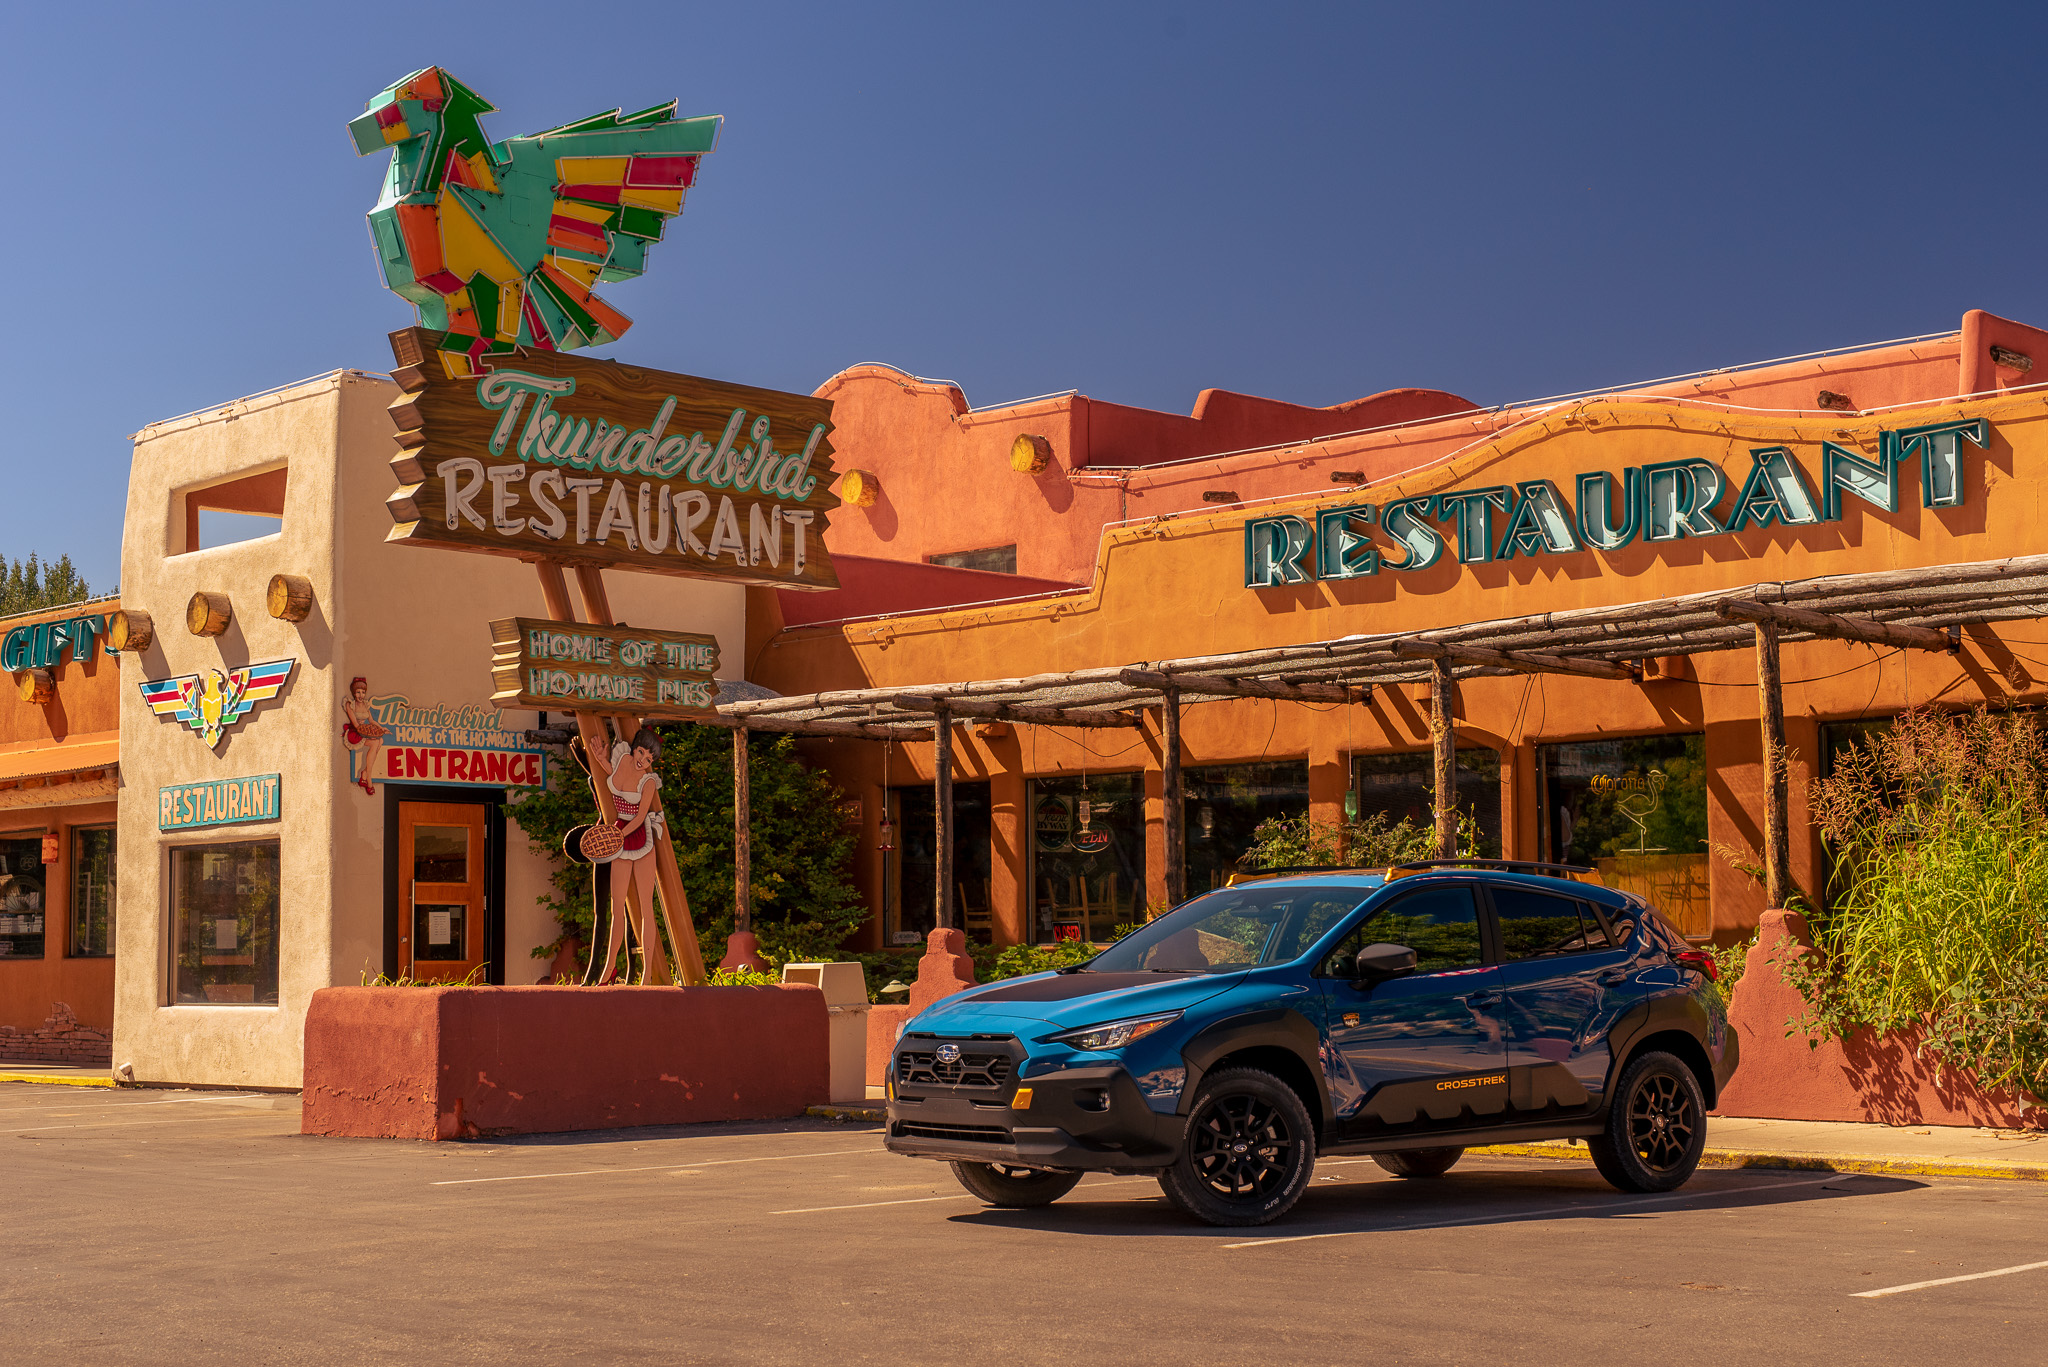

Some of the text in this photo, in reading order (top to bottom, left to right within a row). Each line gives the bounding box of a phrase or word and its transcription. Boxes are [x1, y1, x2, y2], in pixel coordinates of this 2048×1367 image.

[476, 369, 826, 502] Thunderbird
[436, 457, 814, 576] RESTAURANT
[1245, 417, 1989, 589] RESTAURANT
[529, 629, 715, 672] HOME OF THE
[657, 679, 713, 708] PIES
[371, 694, 504, 733] Thunderbird
[395, 726, 433, 744] HOME
[448, 729, 469, 746] THE
[469, 731, 515, 749] HO-MADE
[386, 748, 541, 785] ENTRANCE
[1591, 774, 1645, 796] Corona
[160, 778, 277, 827] RESTAURANT
[1053, 925, 1081, 942] CLOSED
[1436, 1075, 1506, 1091] CROSSTREK
